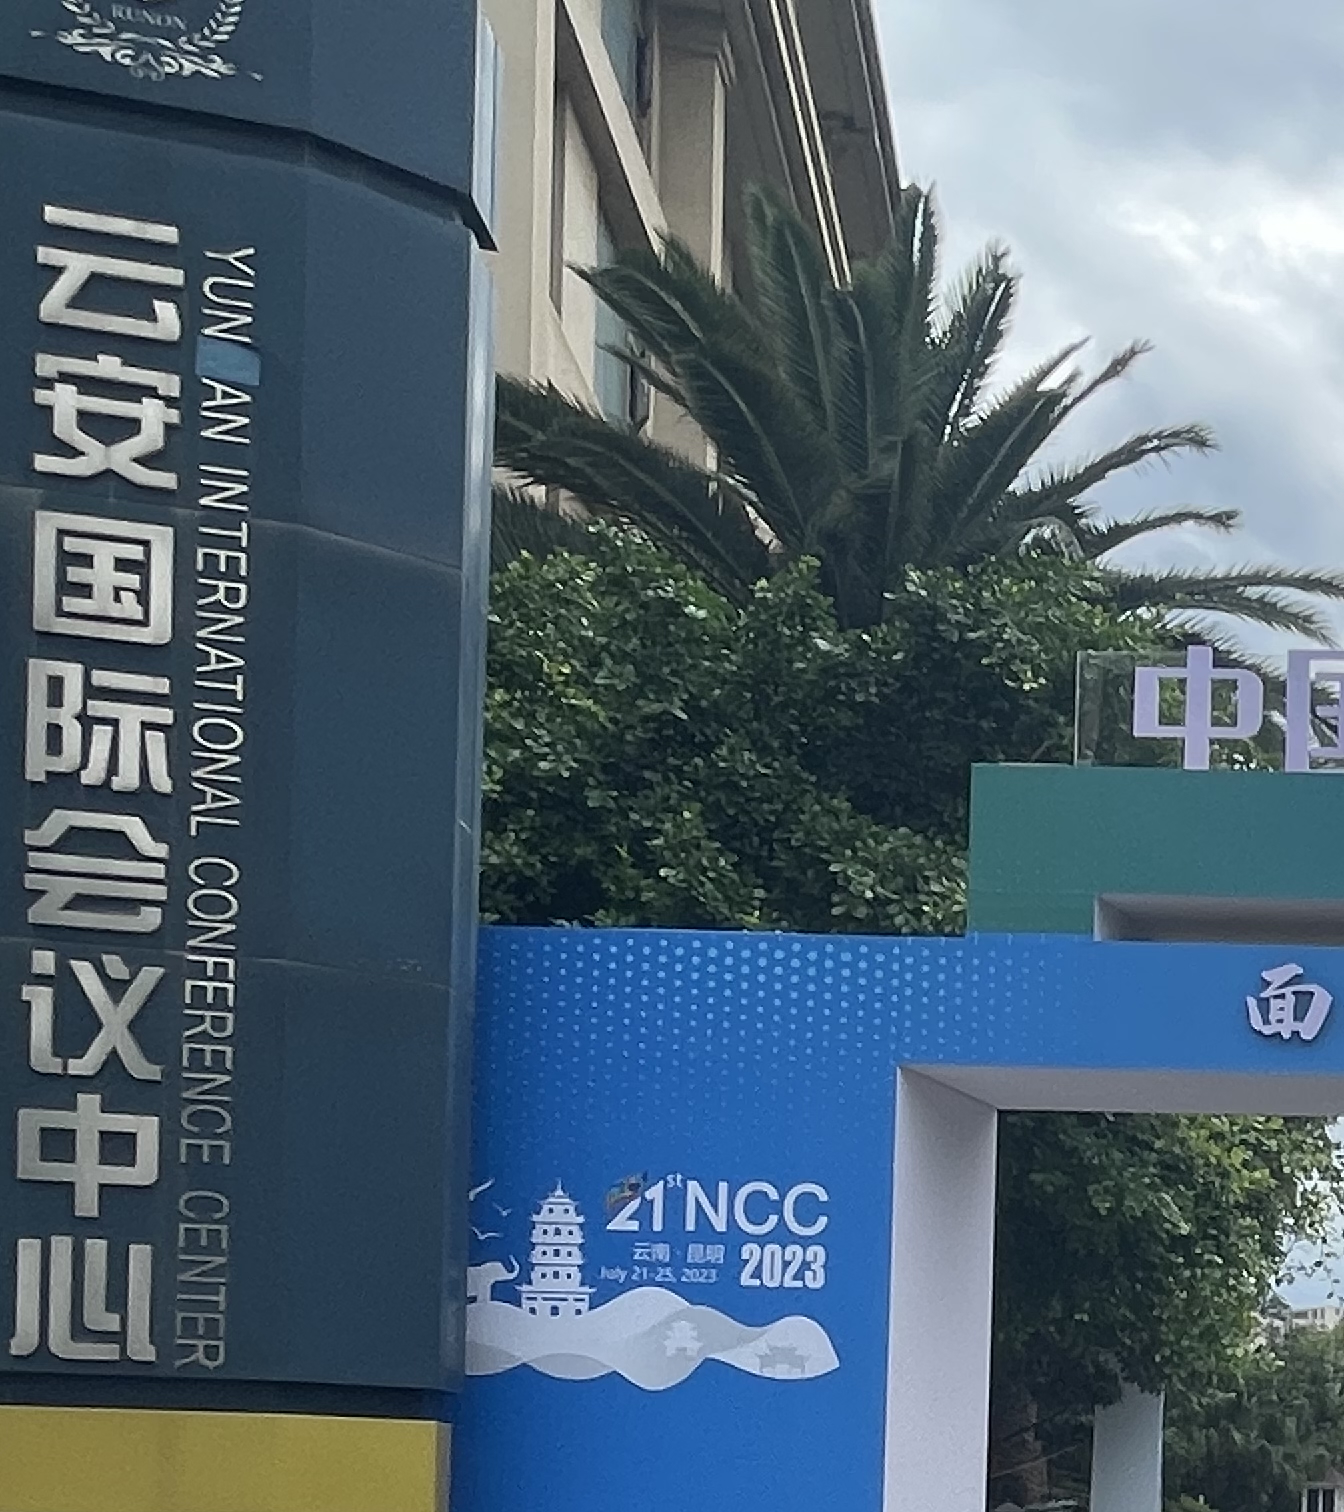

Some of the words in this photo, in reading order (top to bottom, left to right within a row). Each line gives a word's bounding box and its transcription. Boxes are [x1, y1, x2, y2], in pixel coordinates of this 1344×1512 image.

[187, 464, 251, 837] INTERNATIONAL
[9, 203, 186, 1362] 云安国际会议中心
[179, 857, 241, 1167] CONFERENCE
[172, 1189, 232, 1371] CENTER
[680, 1267, 718, 1284] 2023
[685, 1179, 830, 1236] NCC
[739, 1242, 827, 1289] 2023
